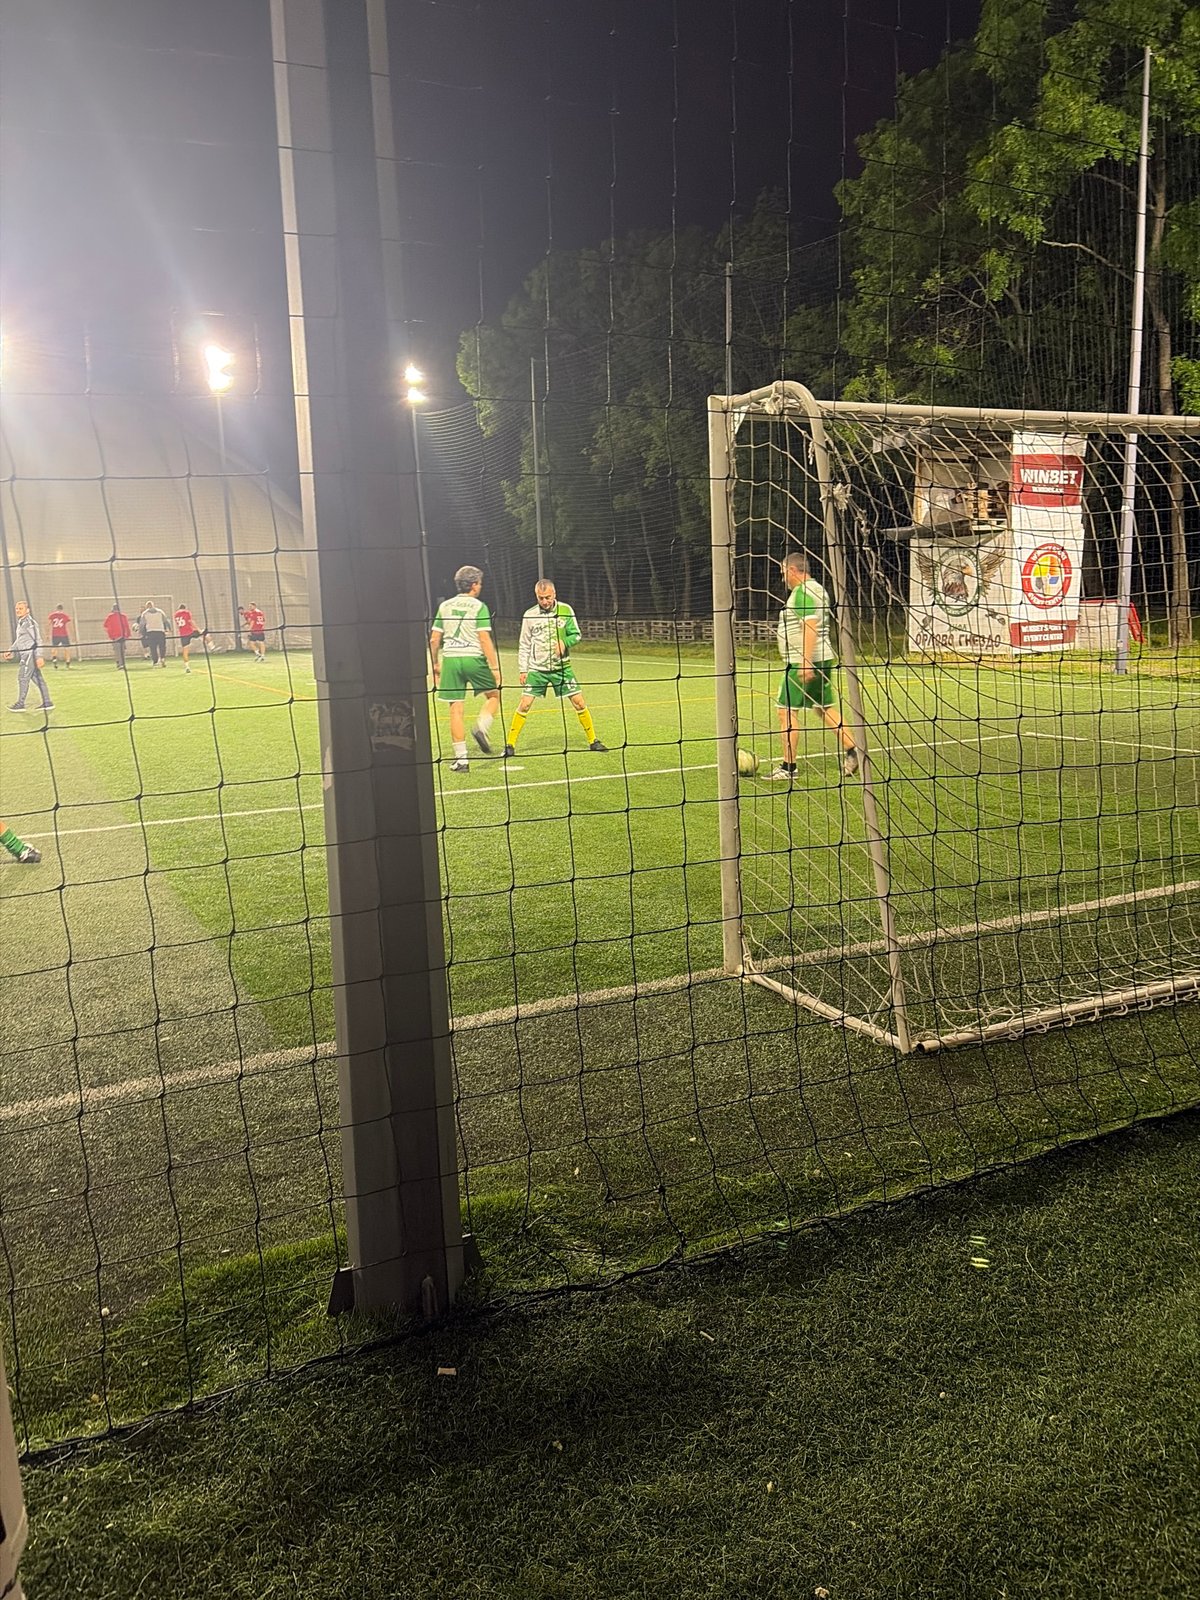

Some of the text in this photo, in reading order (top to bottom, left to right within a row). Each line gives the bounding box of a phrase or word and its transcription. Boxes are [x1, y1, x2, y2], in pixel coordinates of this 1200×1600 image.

[1019, 468, 1079, 485] WINBET
[451, 609, 467, 639] 7
[915, 633, 955, 648] ОРЛОВО
